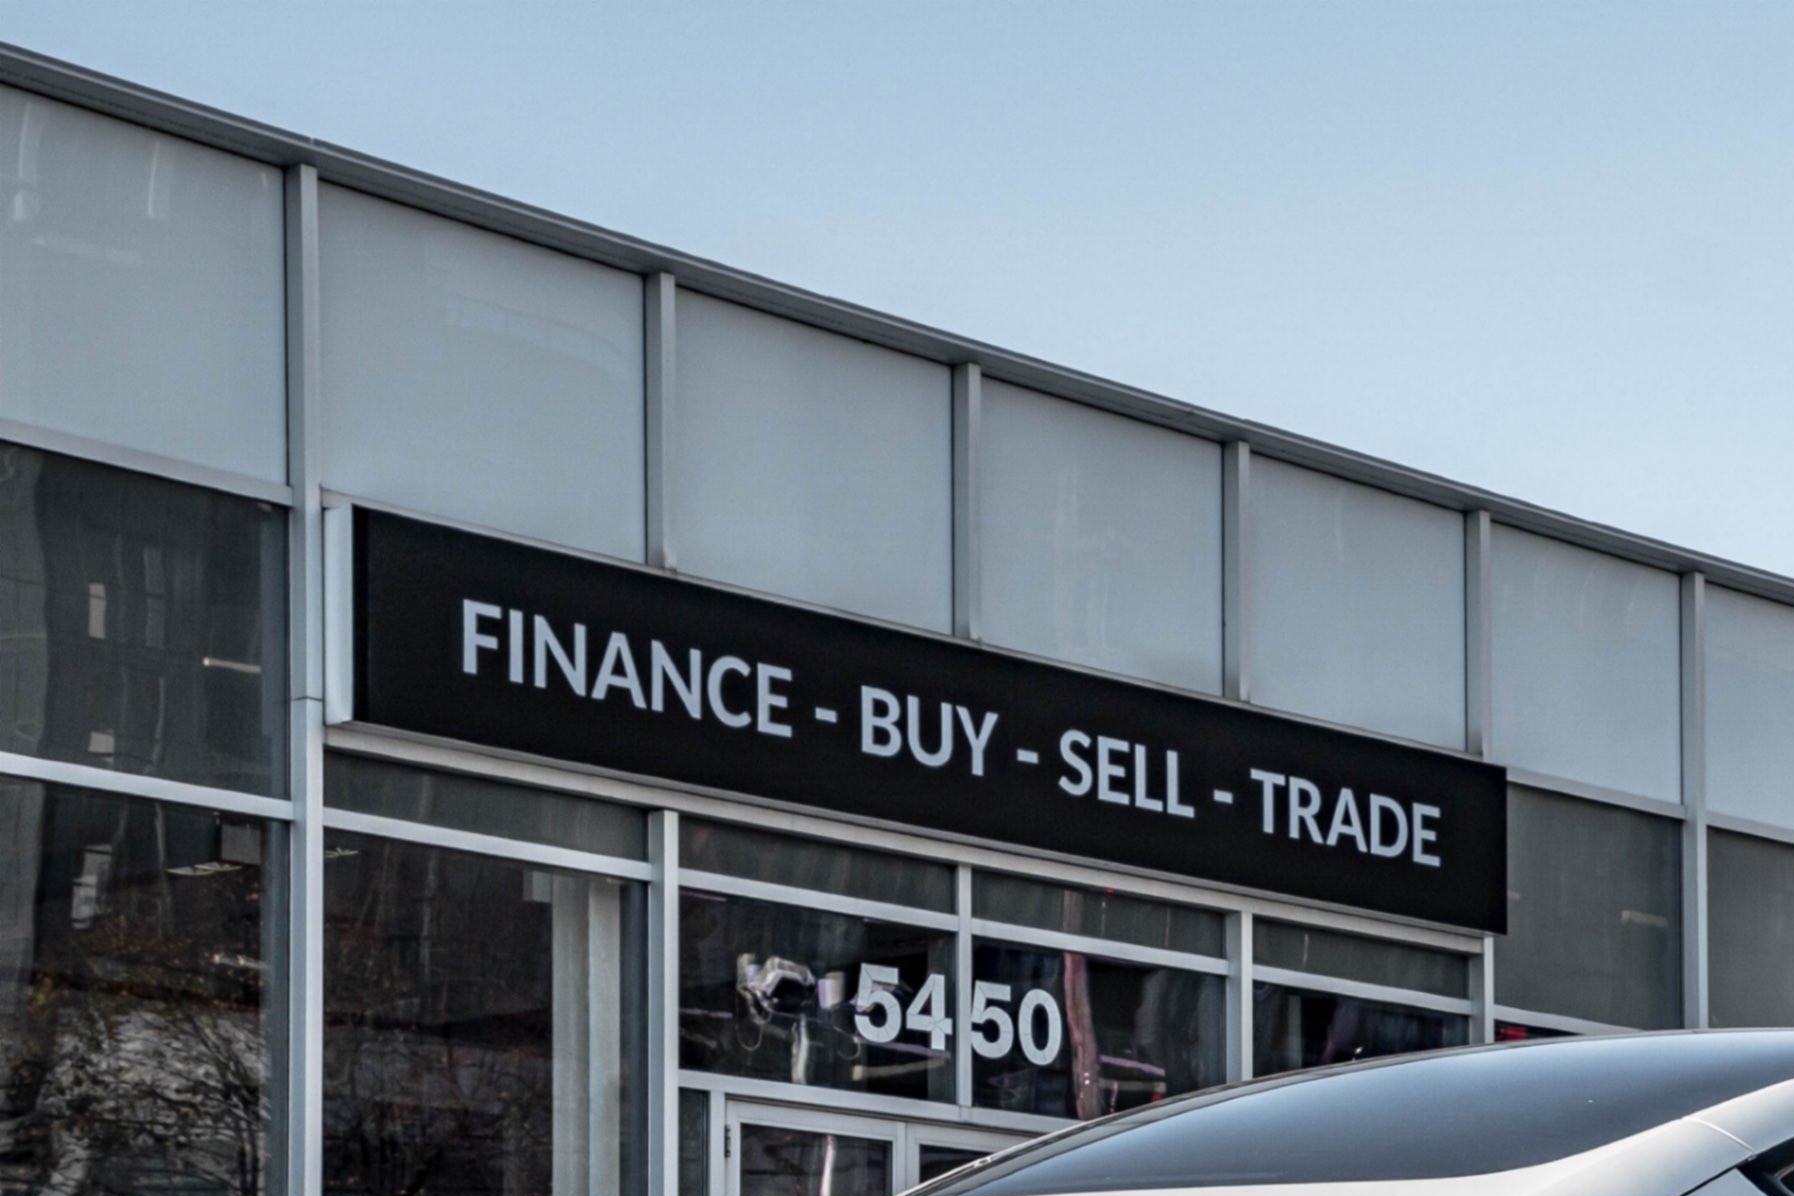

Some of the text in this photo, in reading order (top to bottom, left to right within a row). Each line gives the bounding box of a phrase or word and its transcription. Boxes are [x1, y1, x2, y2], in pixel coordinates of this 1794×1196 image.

[462, 598, 793, 738] FINANCE
[860, 685, 999, 777] BUY
[1058, 729, 1195, 819] SELL
[1250, 767, 1441, 868] TRADE
[854, 962, 1063, 1067] 5450
